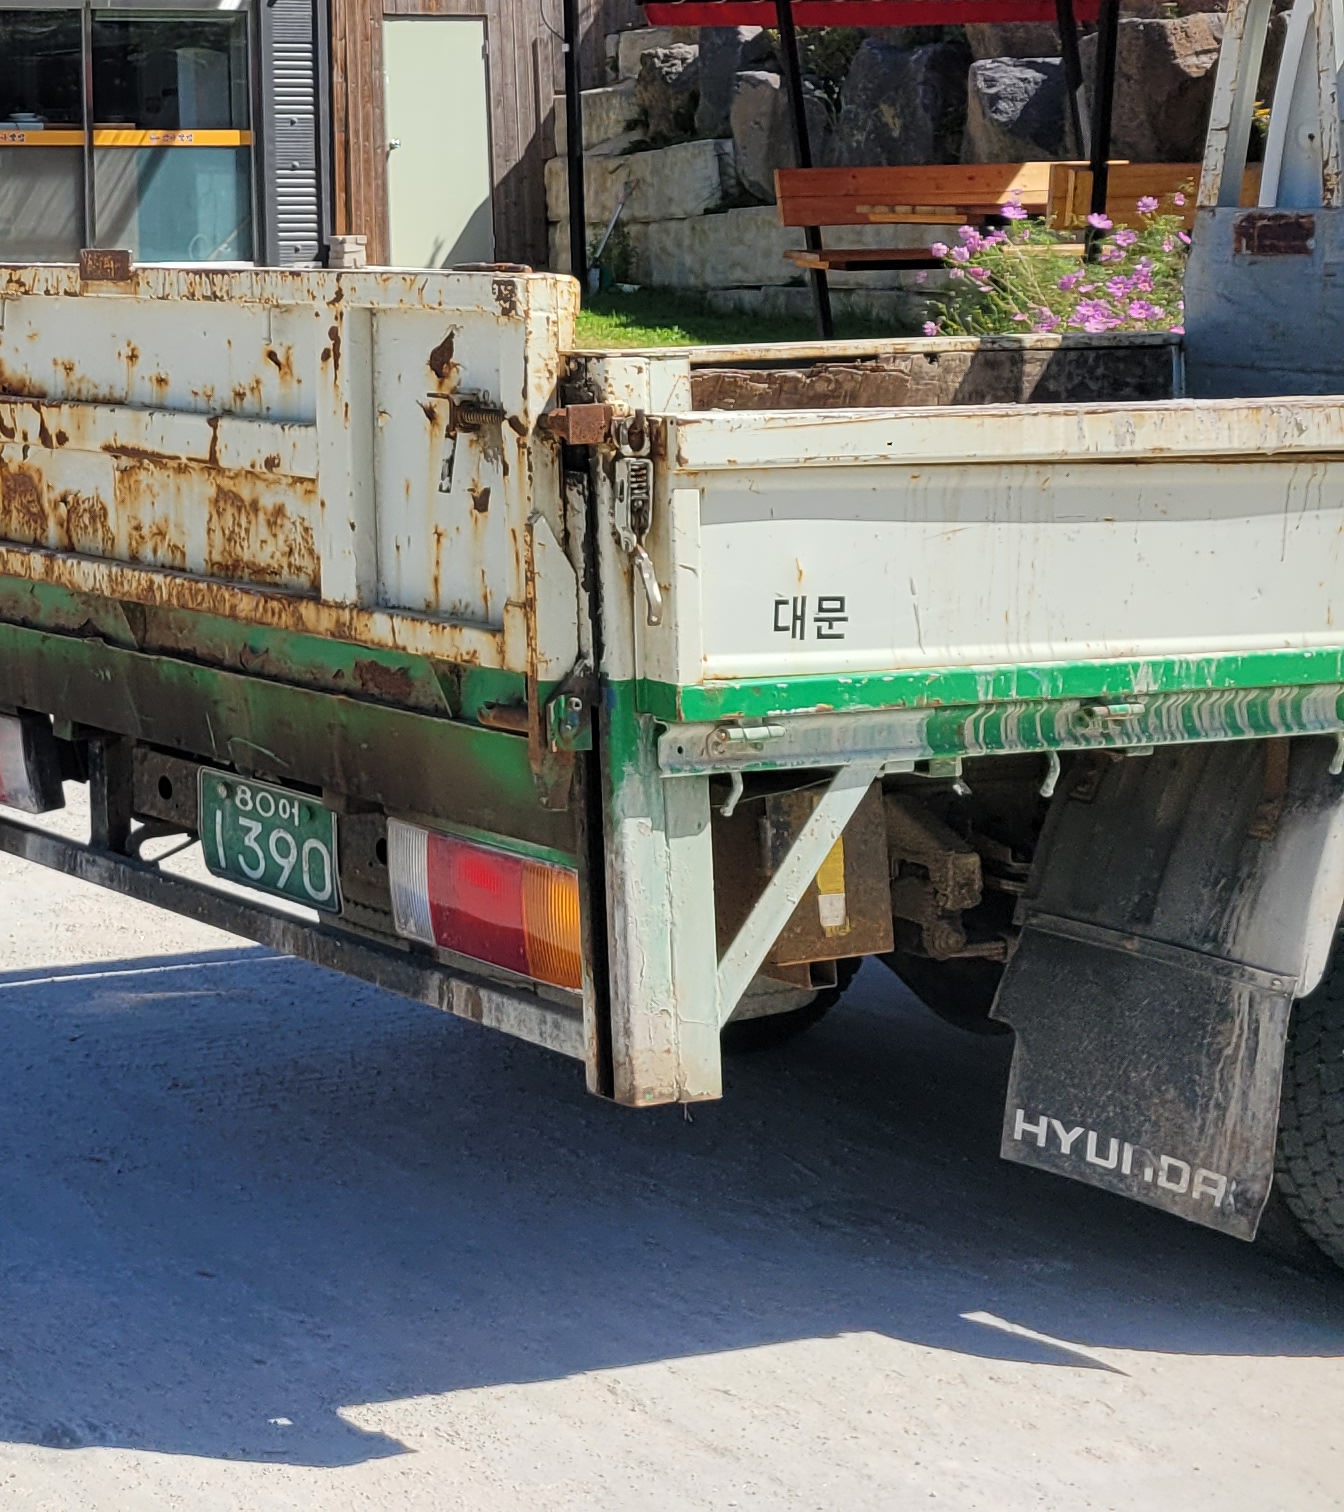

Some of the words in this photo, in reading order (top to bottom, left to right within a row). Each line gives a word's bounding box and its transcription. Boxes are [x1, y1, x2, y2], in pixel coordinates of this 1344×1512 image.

[773, 595, 849, 641] 대문
[235, 785, 299, 827] 80어
[215, 808, 332, 901] 1390
